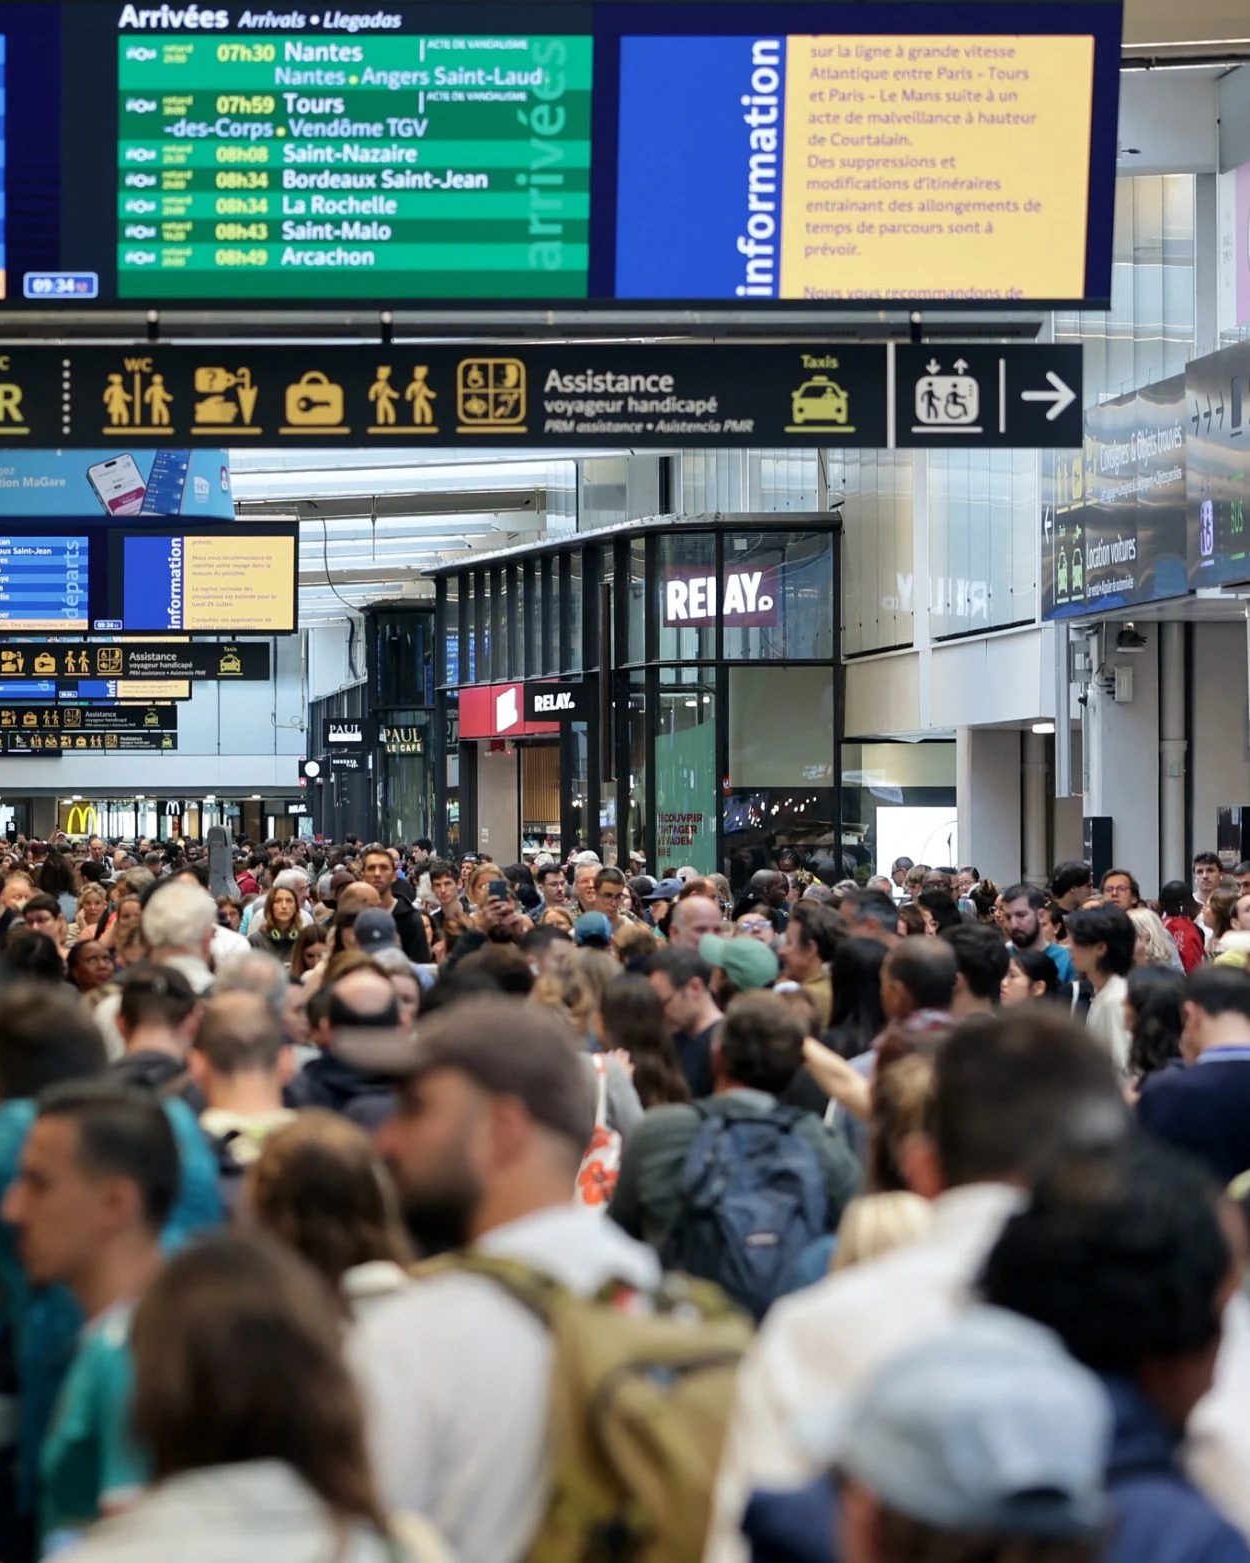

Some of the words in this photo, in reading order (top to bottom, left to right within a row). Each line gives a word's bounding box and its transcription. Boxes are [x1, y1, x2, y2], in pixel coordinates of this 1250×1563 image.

[118, 4, 229, 28] Arrivées
[238, 11, 306, 28] Arrivals
[323, 11, 402, 32] Llegadas
[217, 43, 275, 62] 07h30
[284, 41, 363, 62] Nantes
[810, 47, 836, 59] sur
[838, 46, 851, 59] la
[855, 46, 893, 61] ligne
[896, 44, 904, 58] à
[908, 45, 959, 61] grande
[964, 45, 1015, 58] vitesse
[275, 67, 346, 85] Nantes
[361, 67, 429, 89] Angers
[434, 66, 543, 85] Saint-Laud
[810, 68, 888, 82] Atlantique
[893, 69, 932, 80] entre
[937, 68, 972, 80] Paris
[989, 68, 1029, 81] Tours
[216, 95, 275, 114] 07h59
[283, 92, 344, 114] Tours
[164, 118, 274, 140] -des-Corps
[288, 118, 384, 138] Vendôme
[386, 118, 428, 137] TGV
[283, 144, 418, 163] Saint-Nazaire
[515, 39, 567, 271] arrivées
[735, 39, 780, 297] information
[283, 169, 376, 188] Bordeaux
[382, 169, 488, 189] Saint-Jean
[282, 195, 305, 214] La
[311, 195, 398, 214] Rochelle
[282, 221, 391, 240] Saint-Malo
[281, 246, 374, 266] Arcachon
[124, 358, 152, 372] WC
[802, 354, 838, 369] Taxis
[544, 369, 674, 393] Assistance
[544, 399, 624, 417] voyageur
[628, 396, 718, 417] handicapé
[1100, 440, 1129, 475] Consignes
[1137, 428, 1157, 466] Objets
[1158, 419, 1182, 454] trouvés
[23, 476, 66, 487] MaGare
[1086, 535, 1110, 569] Location
[1111, 534, 1135, 565] voitures
[167, 538, 181, 629] information
[667, 572, 762, 621] RELAY
[129, 651, 177, 662] Assistance
[129, 662, 158, 671] voyageur
[159, 661, 192, 671] handicapé
[534, 693, 571, 712] RELAY
[330, 724, 361, 734] PAUL
[383, 728, 422, 742] PAUL
[387, 744, 396, 753] LE
[401, 742, 421, 753] CAFÉ
